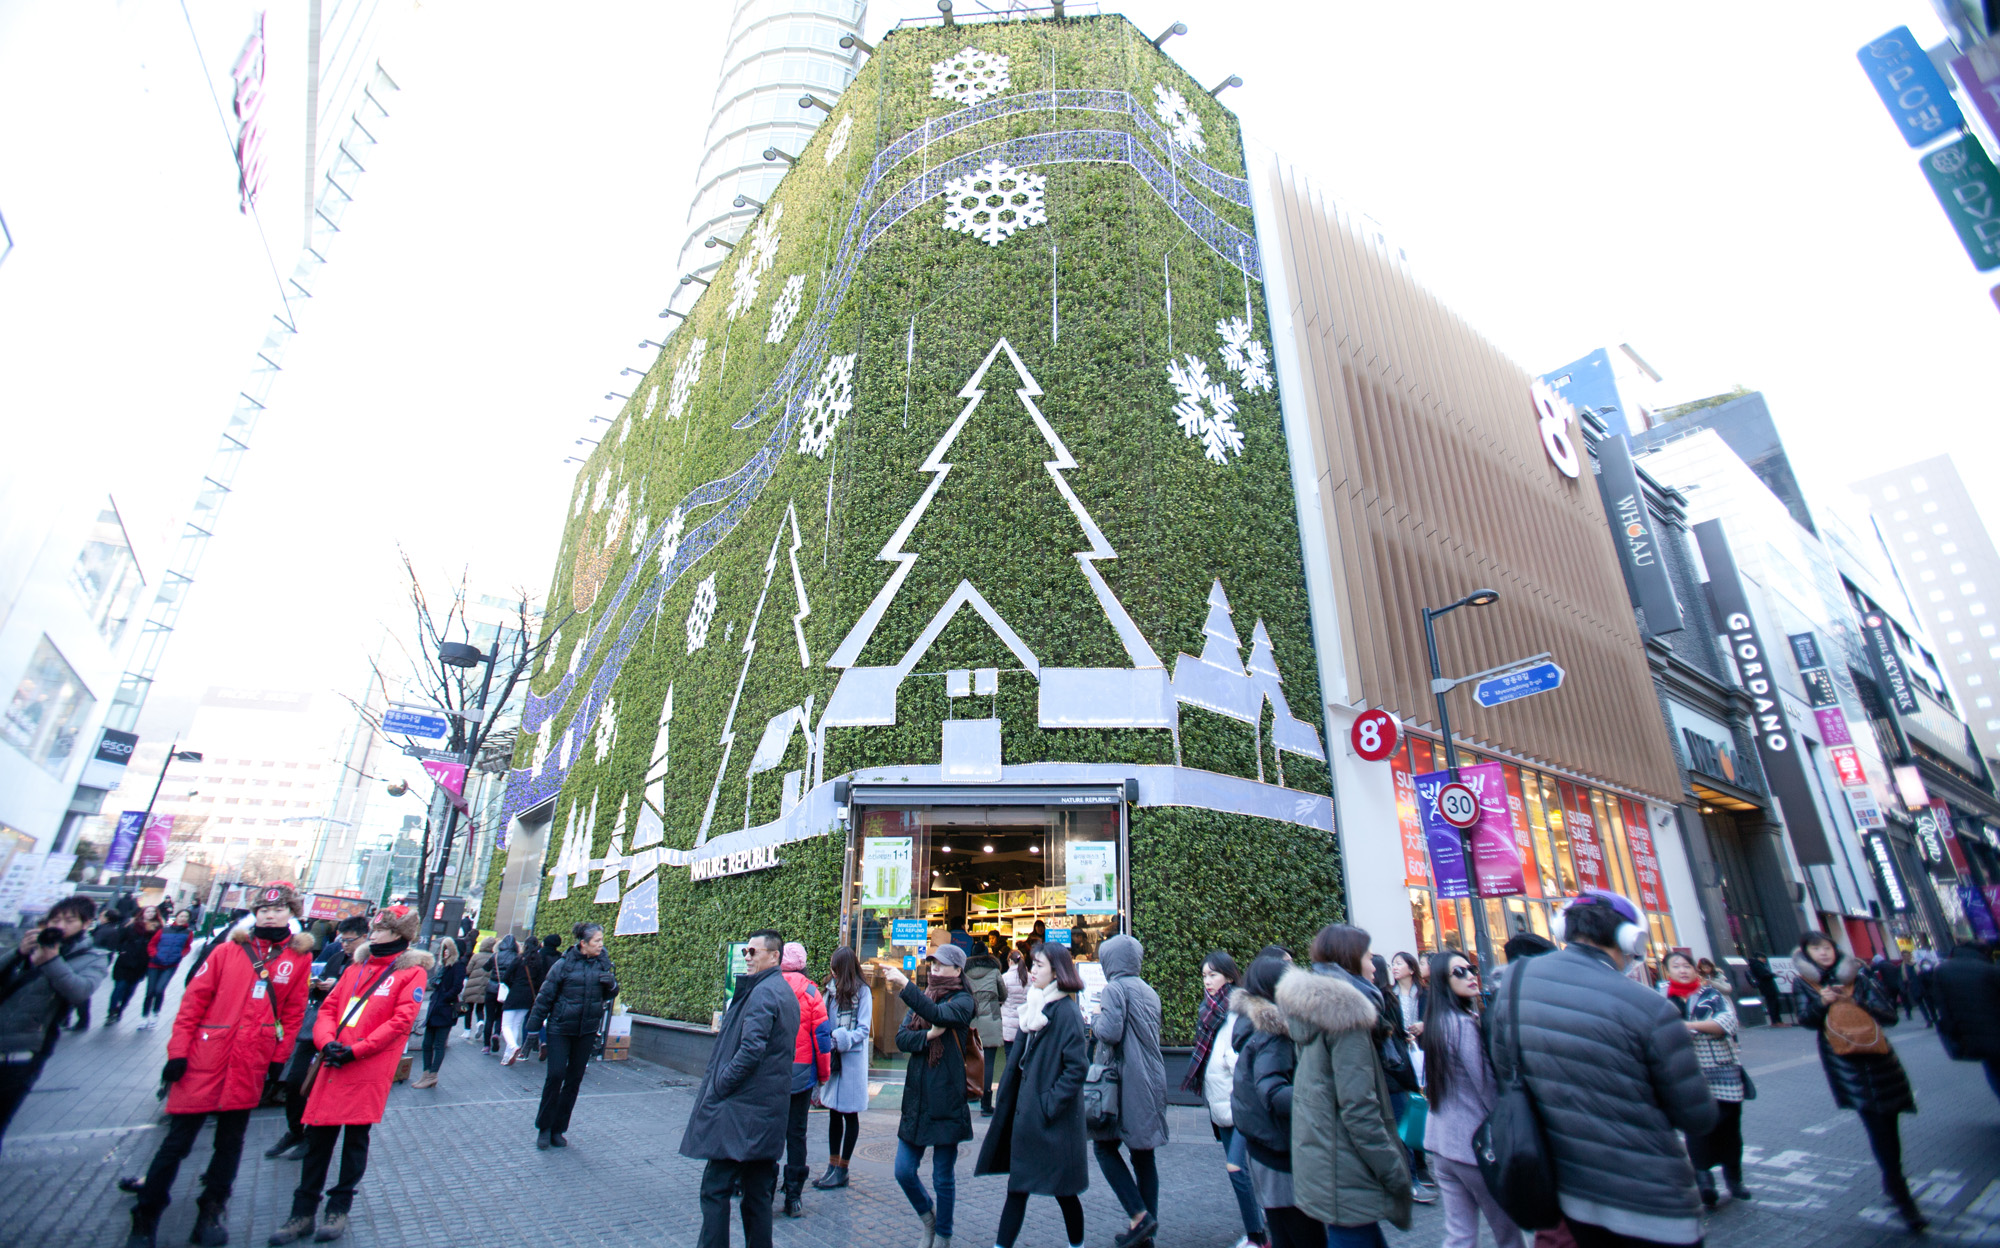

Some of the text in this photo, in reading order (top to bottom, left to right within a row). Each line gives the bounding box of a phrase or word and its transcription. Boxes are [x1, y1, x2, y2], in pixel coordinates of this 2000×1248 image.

[1873, 629, 1914, 710] HOTEL SKYPARK
[1502, 672, 1530, 686] 명동8길
[1726, 612, 1787, 751] GIORDANO
[1494, 682, 1530, 695] Myeongdong
[1447, 796, 1472, 814] 30
[1568, 811, 1593, 828] SUPER
[1933, 807, 1954, 839] SPAO
[1571, 826, 1592, 842] SALE
[1629, 825, 1651, 840] SUPER
[1915, 816, 1942, 862] Roem
[893, 850, 908, 860] 1+1
[1575, 842, 1601, 860] 슈퍼세일
[1632, 840, 1650, 854] SALE
[690, 842, 780, 880] NATURE REPUBLIC
[1408, 861, 1432, 877] 60%
[1870, 836, 1906, 909] LINE FRIENDS
[1644, 893, 1659, 905] 60%
